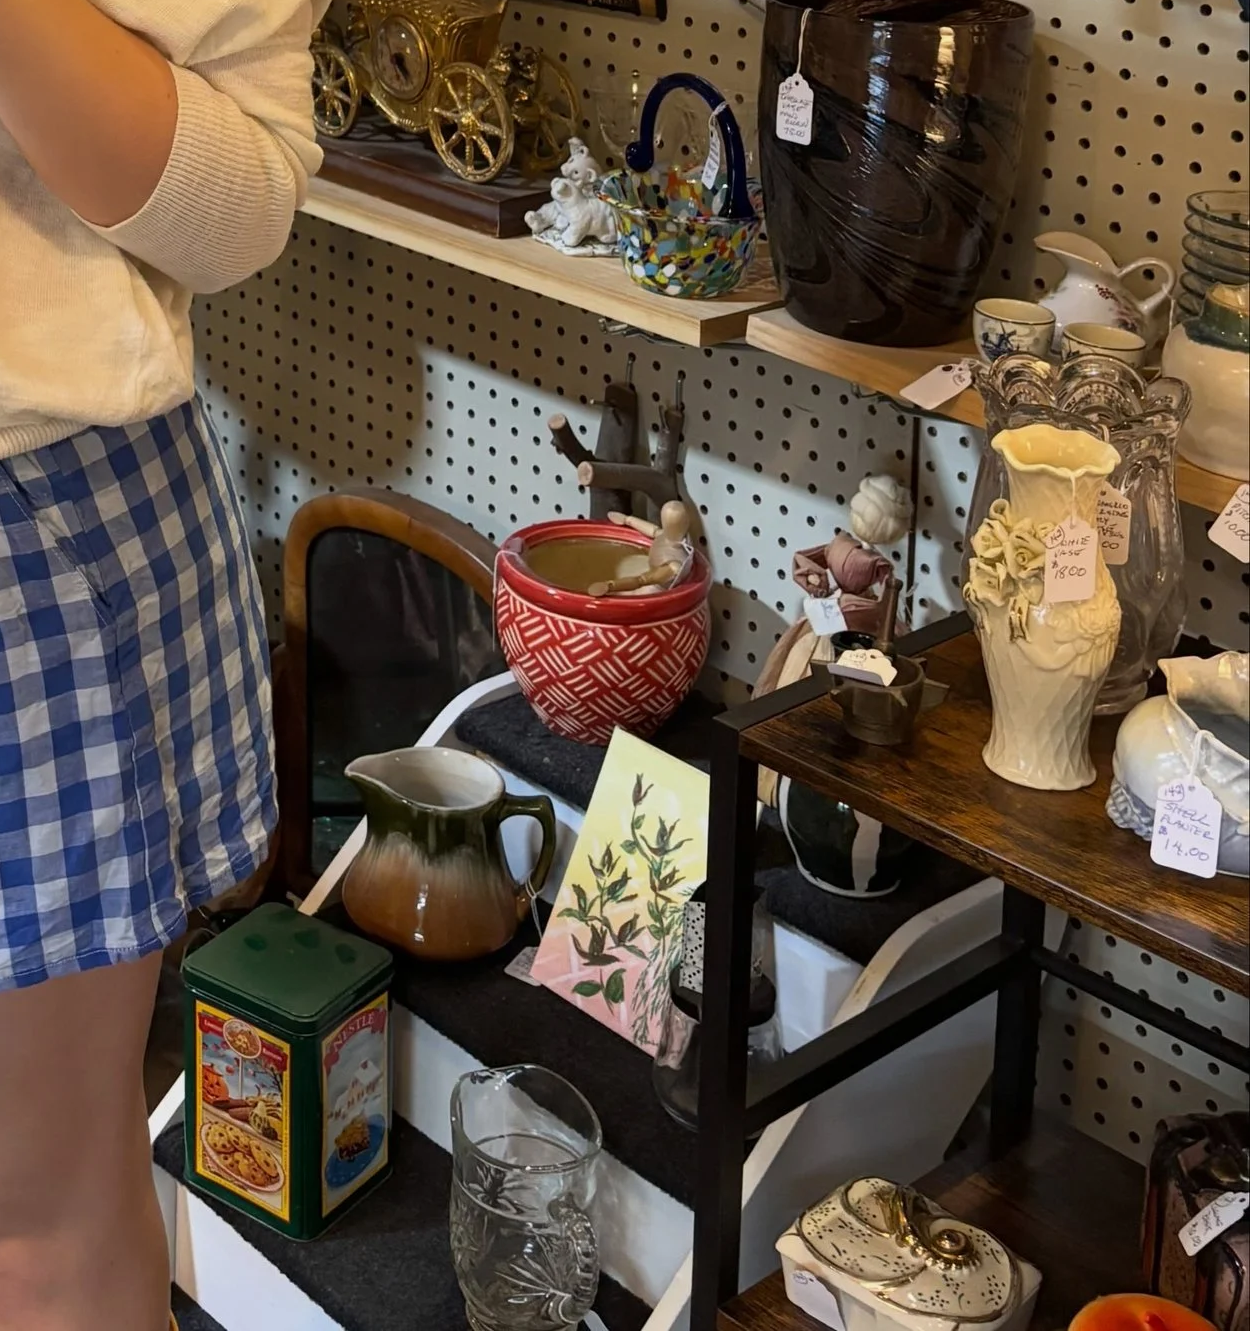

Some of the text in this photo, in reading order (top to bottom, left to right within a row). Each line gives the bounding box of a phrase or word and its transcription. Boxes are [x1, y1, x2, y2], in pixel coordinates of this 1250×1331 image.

[1164, 783, 1183, 797] 142
[1164, 801, 1210, 826] SHELL
[1159, 814, 1215, 841] PLANTER
